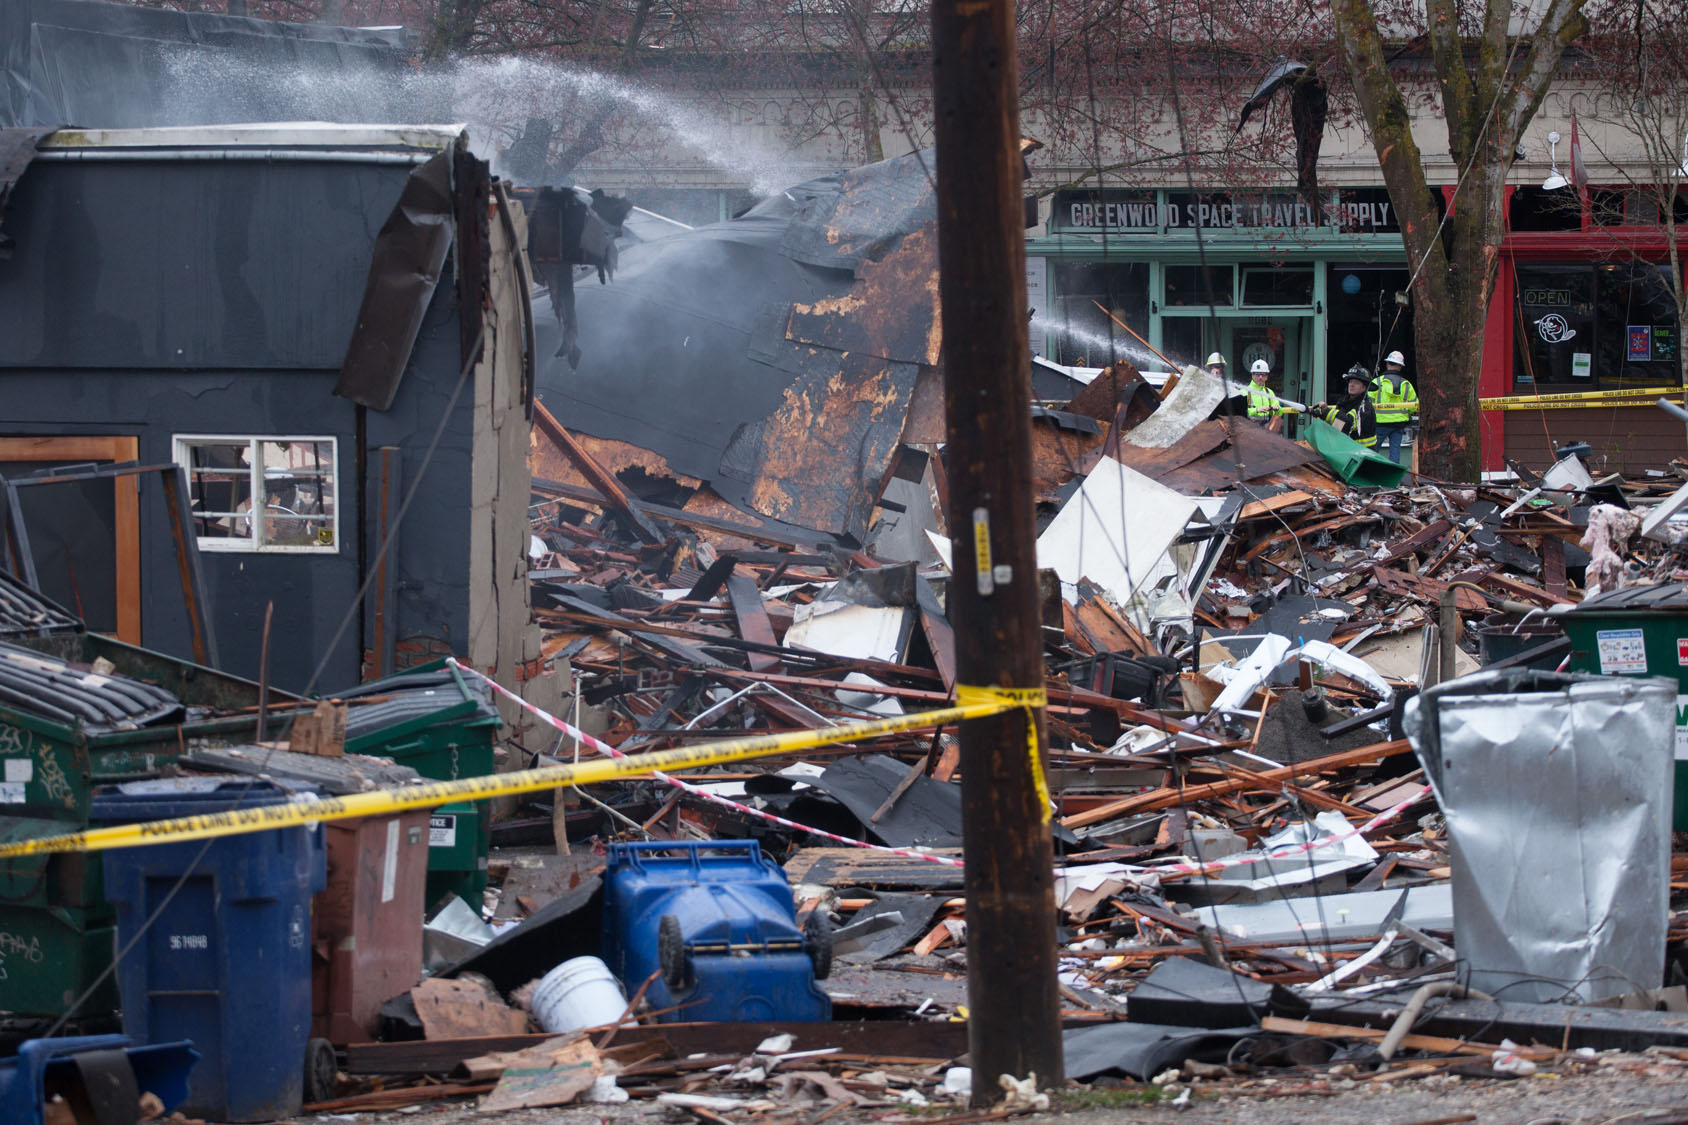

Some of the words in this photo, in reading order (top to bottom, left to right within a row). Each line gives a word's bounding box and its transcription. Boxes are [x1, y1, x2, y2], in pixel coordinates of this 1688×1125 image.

[1071, 203, 1180, 227] GREENWOOD
[1187, 203, 1244, 227] SPACE
[1252, 202, 1316, 227] TRAVEL
[1323, 202, 1389, 227] SUPPLY
[1526, 291, 1568, 304] OPEN
